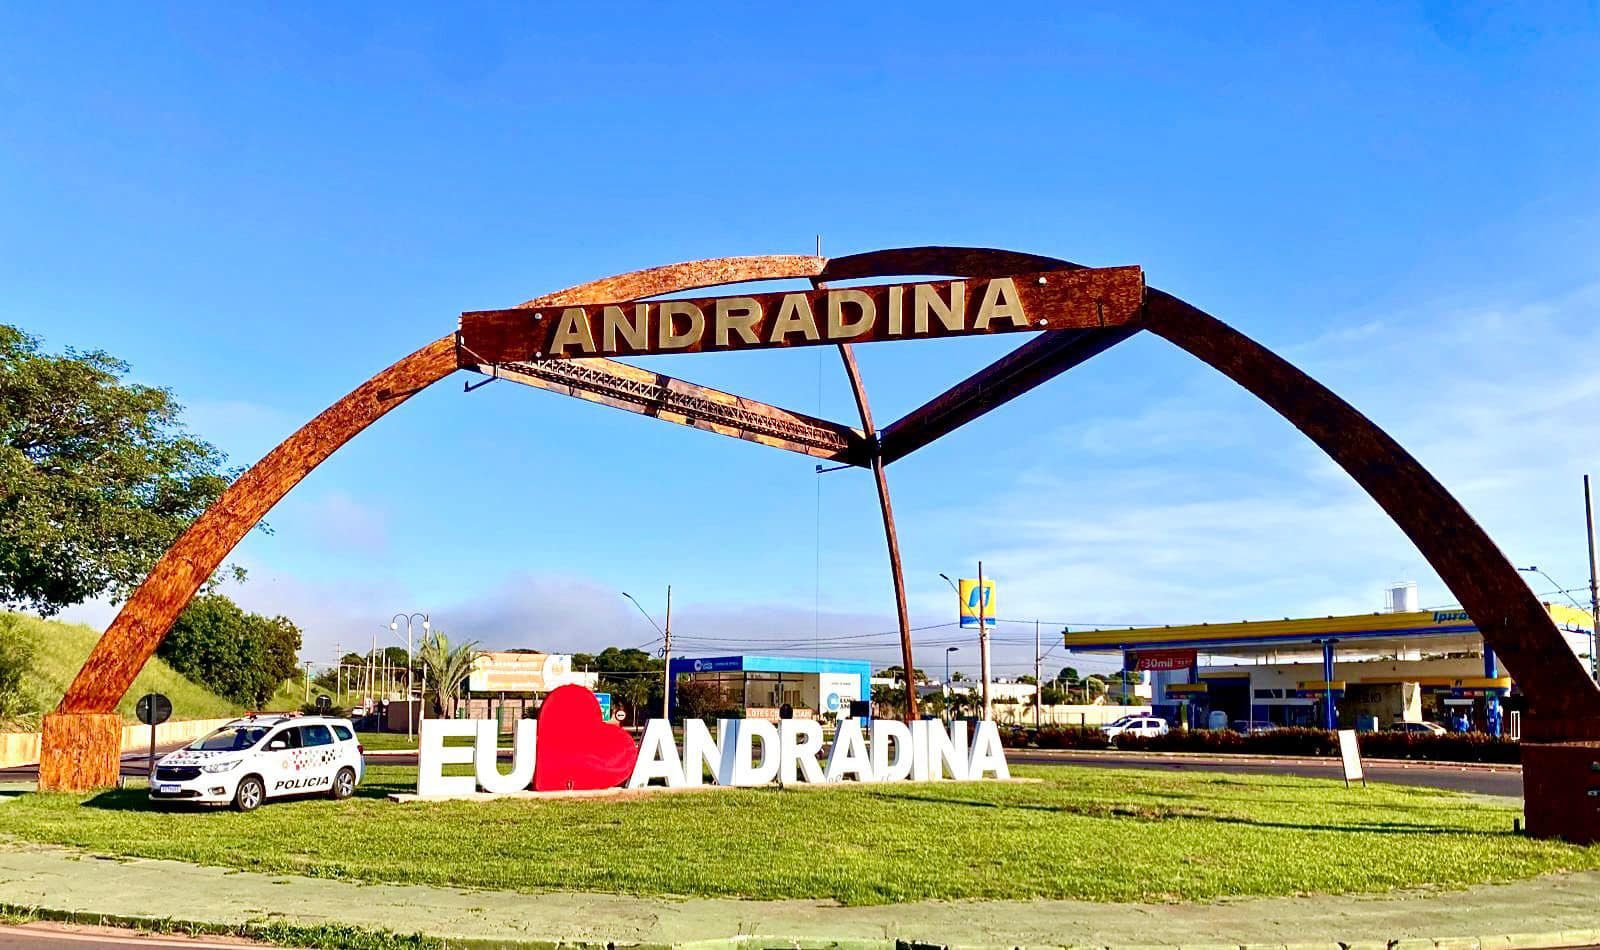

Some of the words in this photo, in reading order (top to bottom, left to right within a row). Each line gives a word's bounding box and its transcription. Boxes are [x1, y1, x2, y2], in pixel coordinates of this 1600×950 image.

[549, 277, 1029, 354] ANDRADINA
[1433, 611, 1468, 624] Ipira
[418, 719, 537, 796] EU
[627, 719, 1011, 788] ANDRADINA
